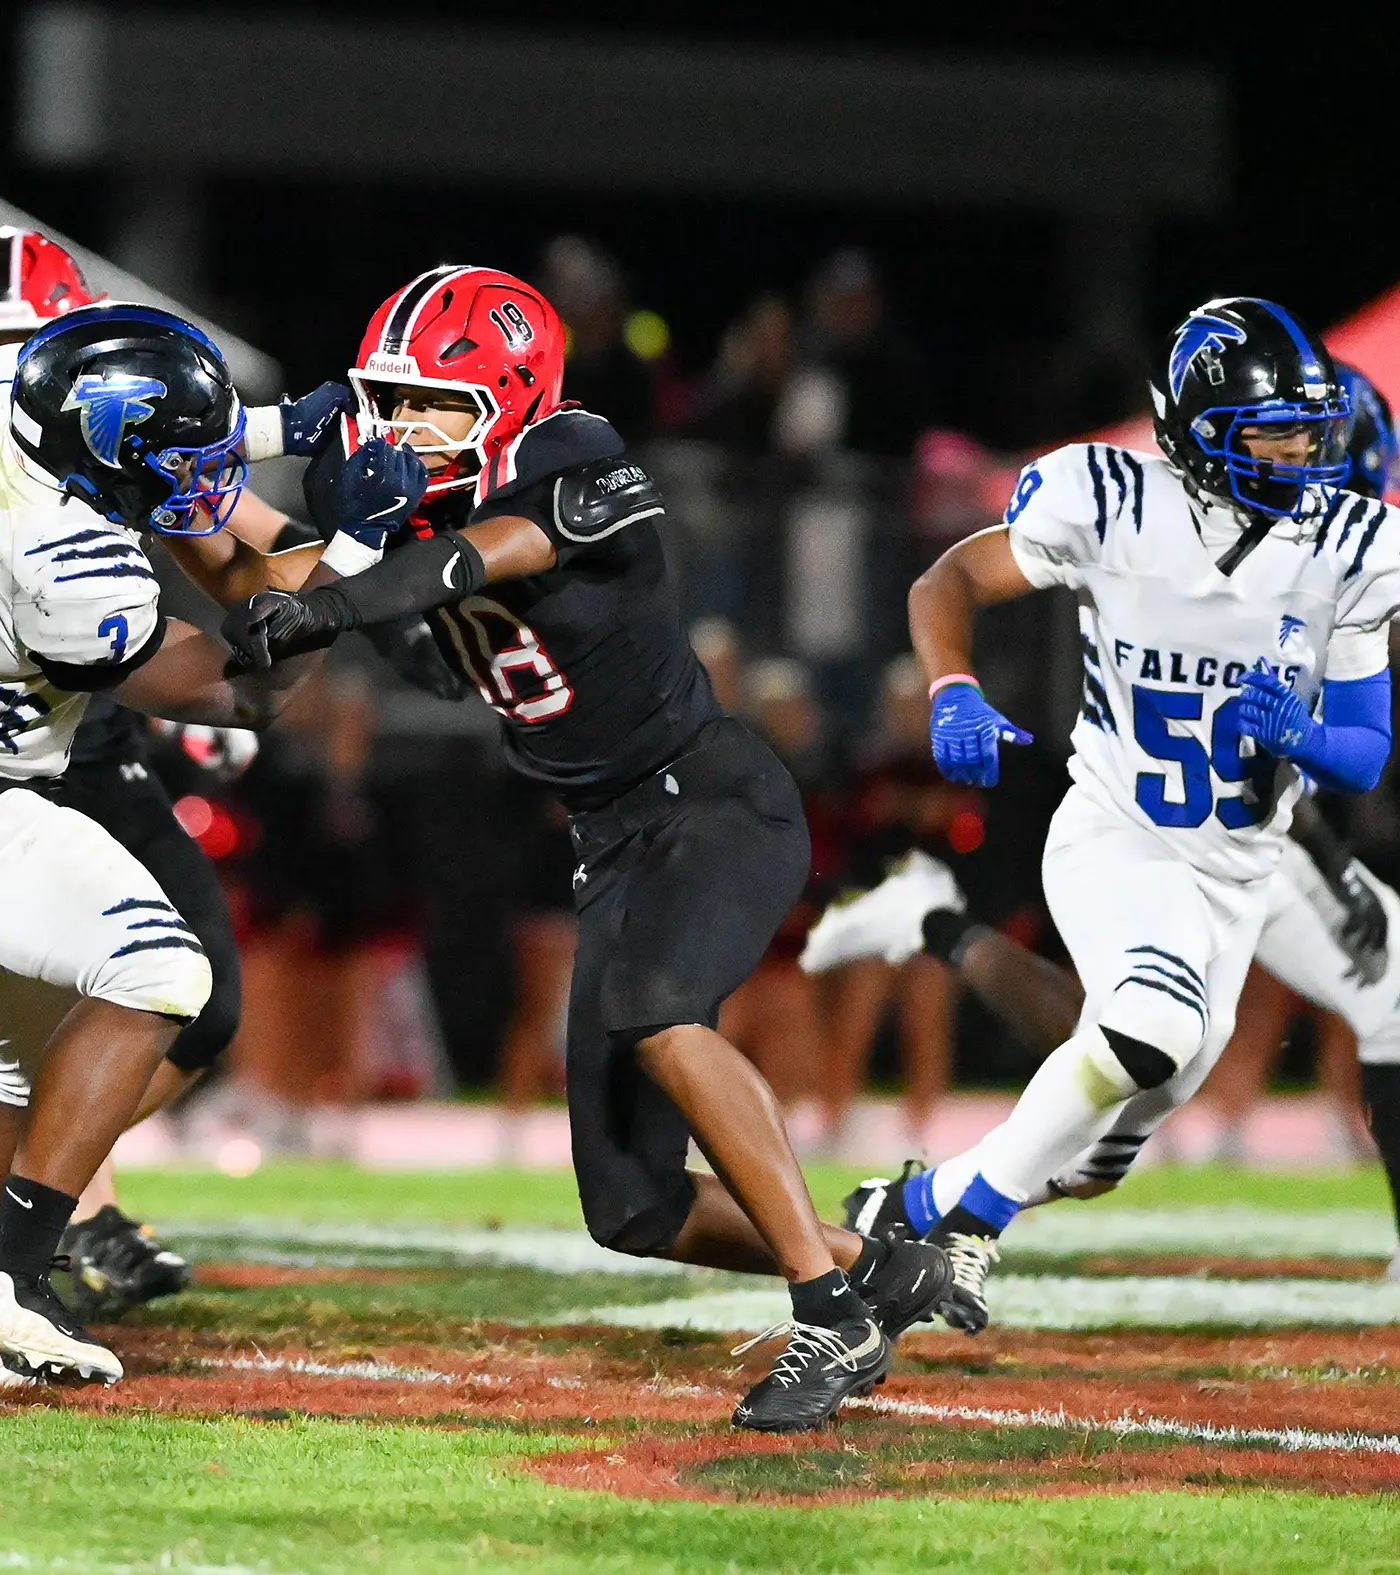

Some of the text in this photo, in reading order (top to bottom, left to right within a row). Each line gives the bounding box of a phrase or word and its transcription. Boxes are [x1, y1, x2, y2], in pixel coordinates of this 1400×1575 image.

[488, 299, 534, 352] 18
[369, 359, 411, 375] Riddell
[97, 614, 129, 665] 3
[436, 595, 575, 724] 18
[1131, 683, 1280, 831] 59
